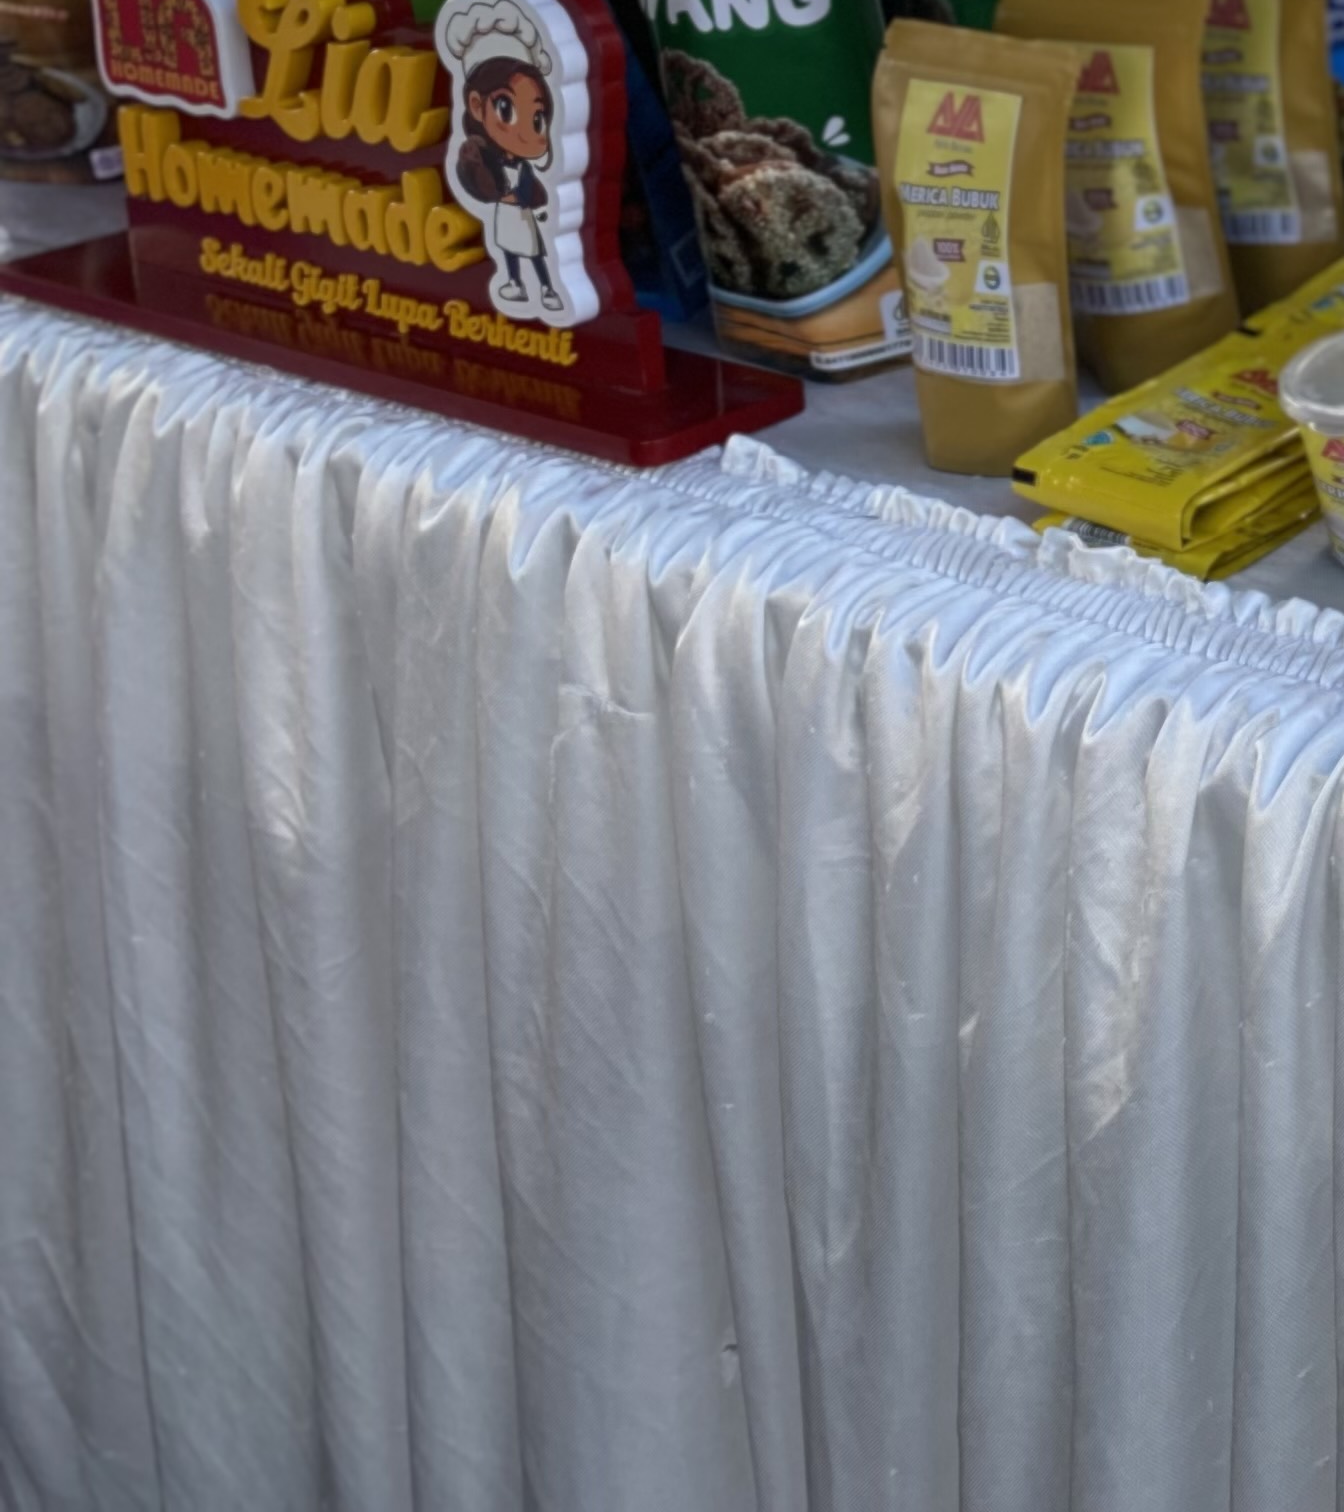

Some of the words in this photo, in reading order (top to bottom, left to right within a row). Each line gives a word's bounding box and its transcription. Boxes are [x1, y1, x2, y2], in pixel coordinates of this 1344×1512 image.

[109, 57, 221, 102] HOMEMADE
[117, 104, 487, 273] Homemade
[950, 186, 1001, 211] BUBUK
[200, 237, 290, 292] Sekali
[291, 261, 363, 315] Gigit
[360, 278, 442, 332] Lupa
[441, 298, 578, 367] Berhenti
